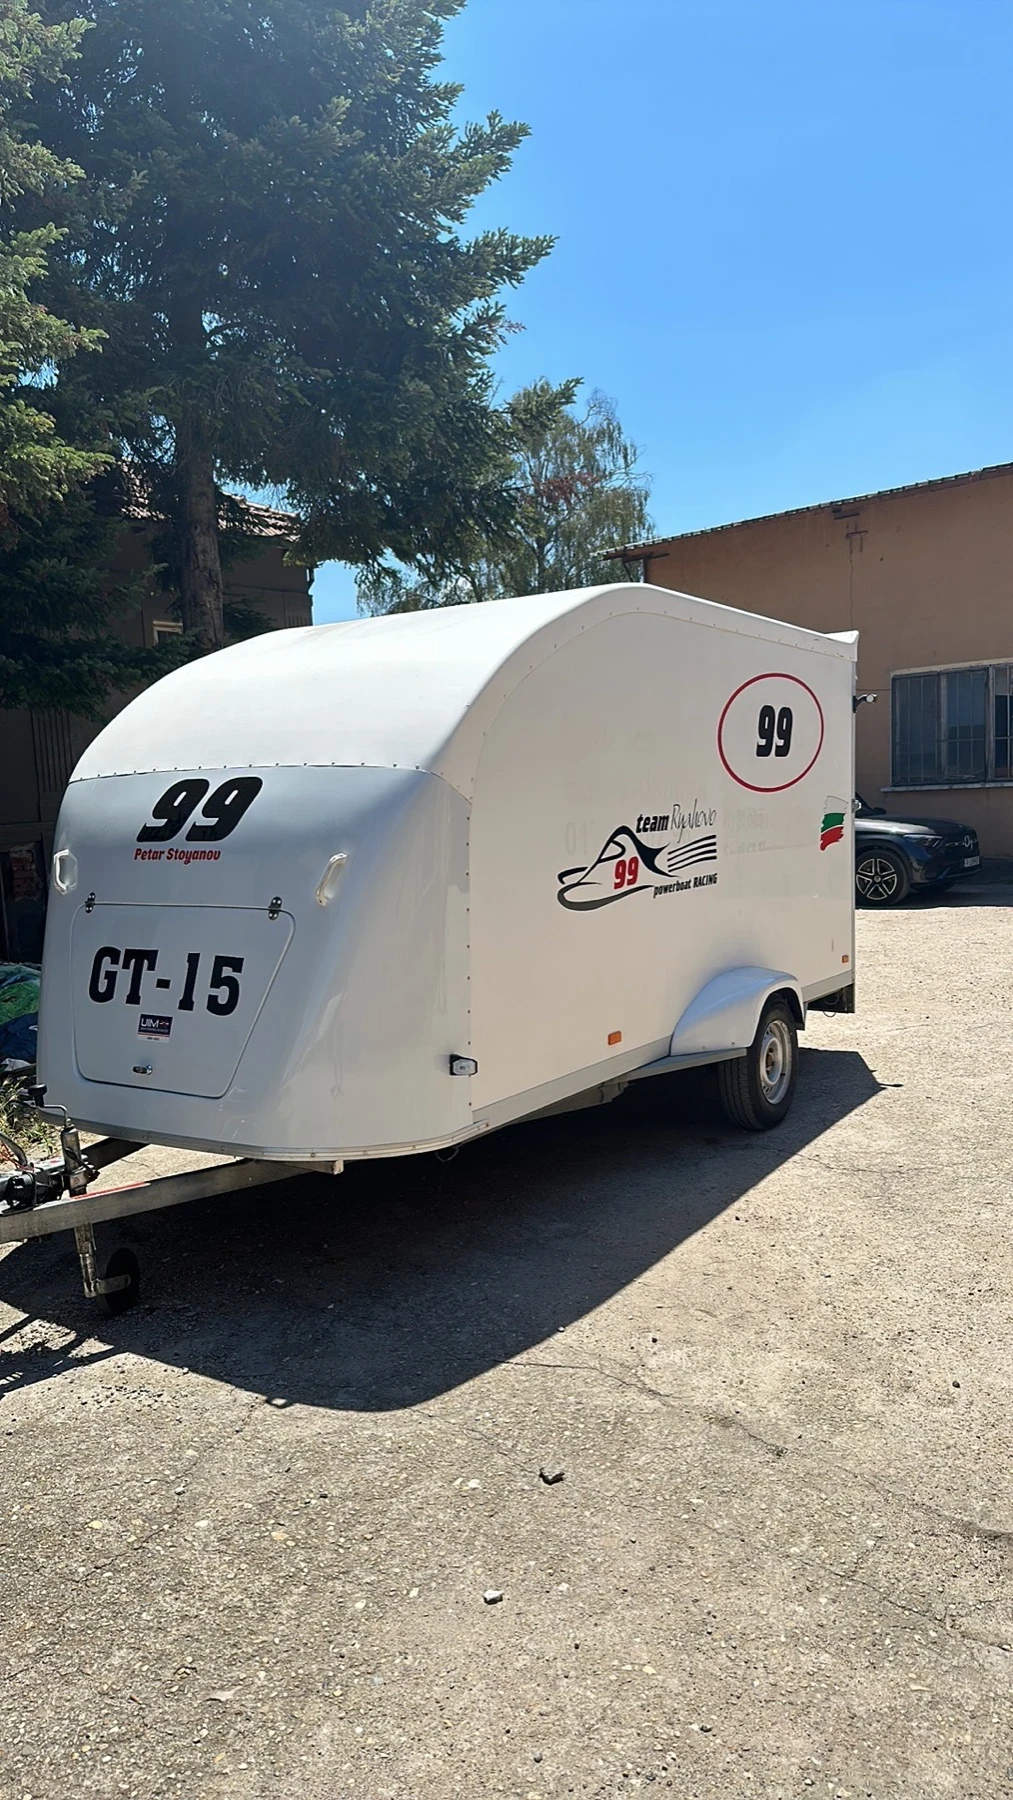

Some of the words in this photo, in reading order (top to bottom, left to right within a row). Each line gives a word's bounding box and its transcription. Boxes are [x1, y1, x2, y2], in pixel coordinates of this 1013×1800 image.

[756, 704, 793, 757] 99
[136, 776, 263, 842] 99
[636, 814, 670, 833] team
[134, 848, 165, 860] Petar
[166, 848, 221, 865] Stoyanov
[614, 856, 639, 889] 99
[653, 880, 692, 899] powerboat
[693, 873, 718, 888] RACING
[88, 946, 245, 1016] GT-15
